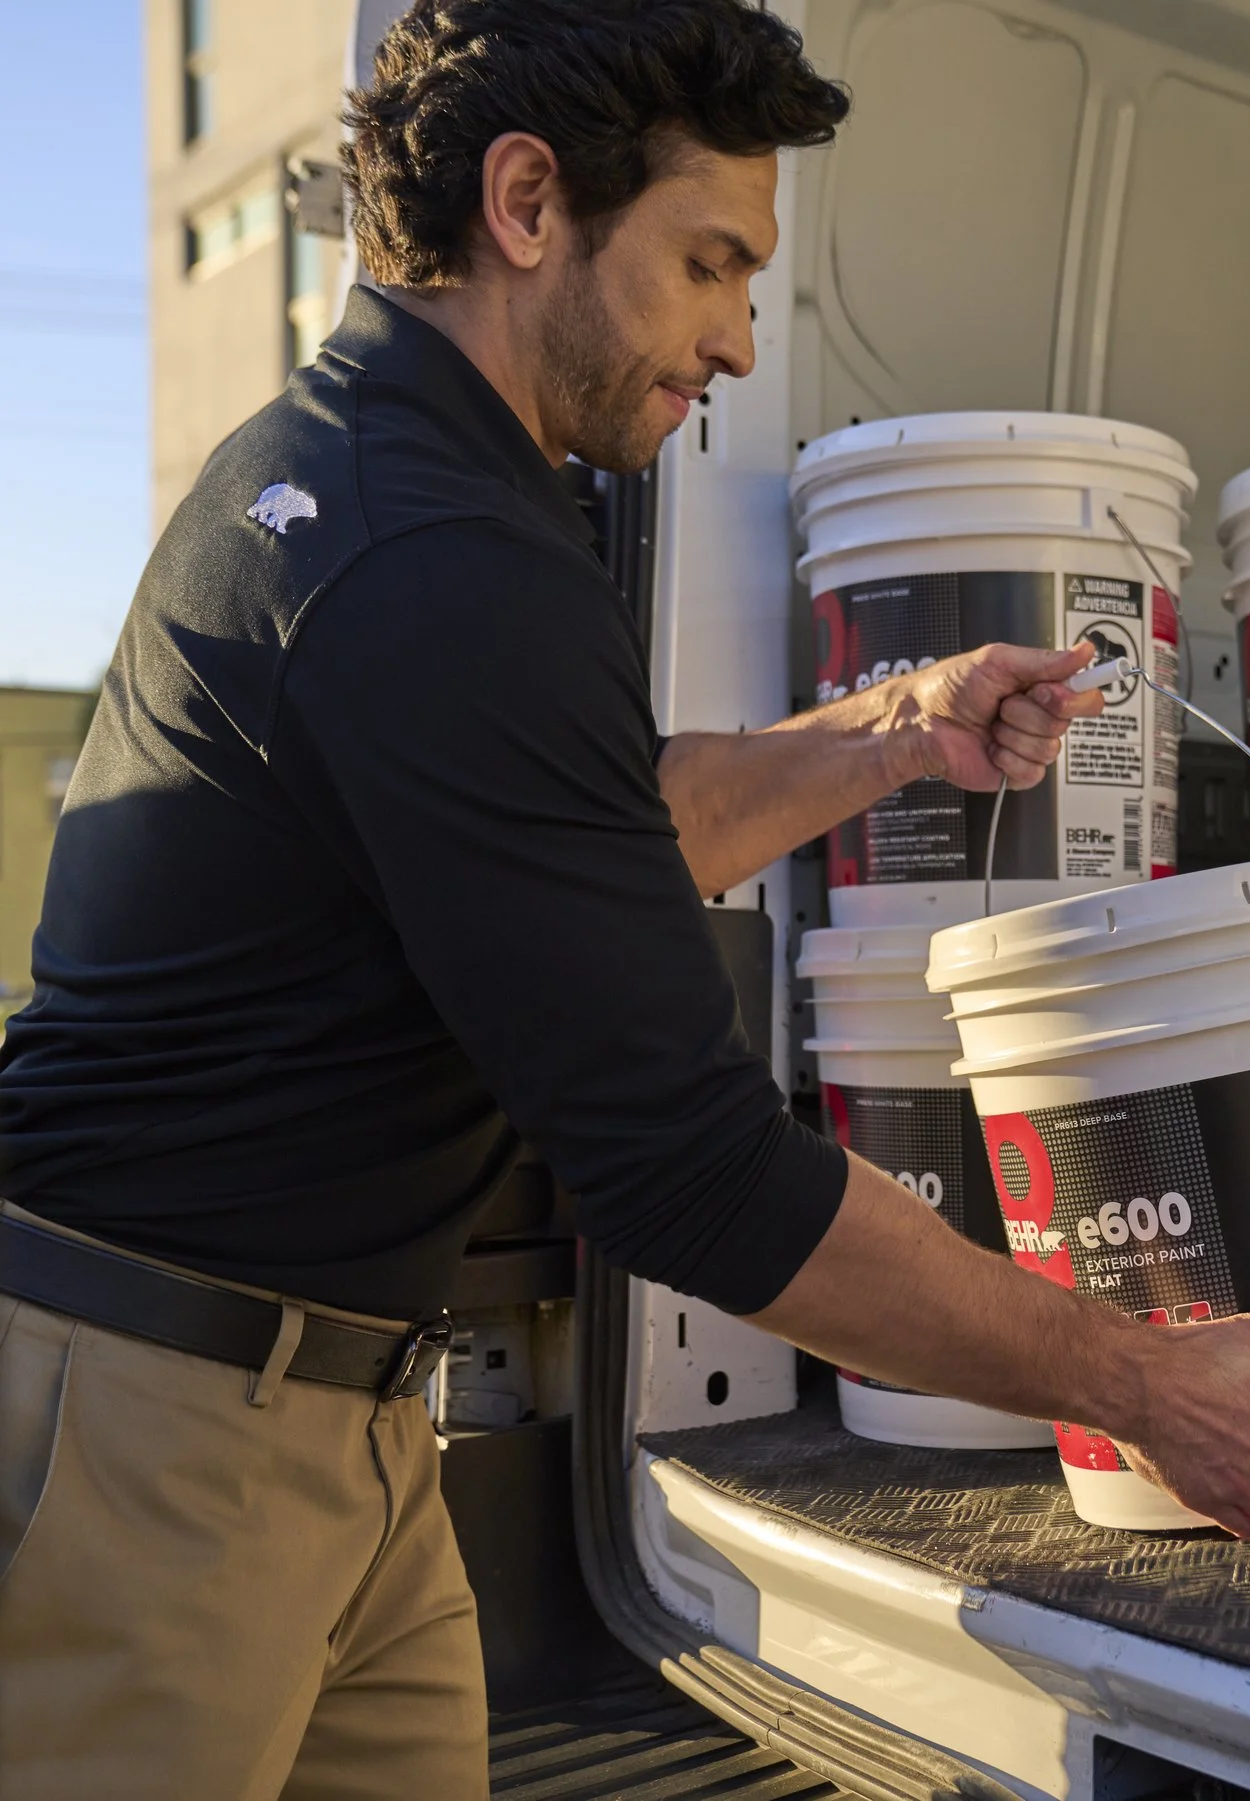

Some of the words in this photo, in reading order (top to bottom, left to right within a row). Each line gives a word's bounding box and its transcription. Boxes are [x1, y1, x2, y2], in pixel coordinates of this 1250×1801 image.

[1084, 579, 1130, 598] WARNING
[1074, 596, 1138, 616] ADVERTENCIA
[1066, 828, 1102, 843] BEHR
[1054, 1120, 1079, 1131] PR613
[1080, 1116, 1102, 1127] DEEP
[1103, 1111, 1127, 1123] BASE
[1077, 1191, 1192, 1249] e600
[1004, 1219, 1042, 1252] BEHR
[1086, 1252, 1155, 1273] EXTERIOR
[1159, 1243, 1205, 1263] PAINT
[1089, 1274, 1122, 1289] FLAT
